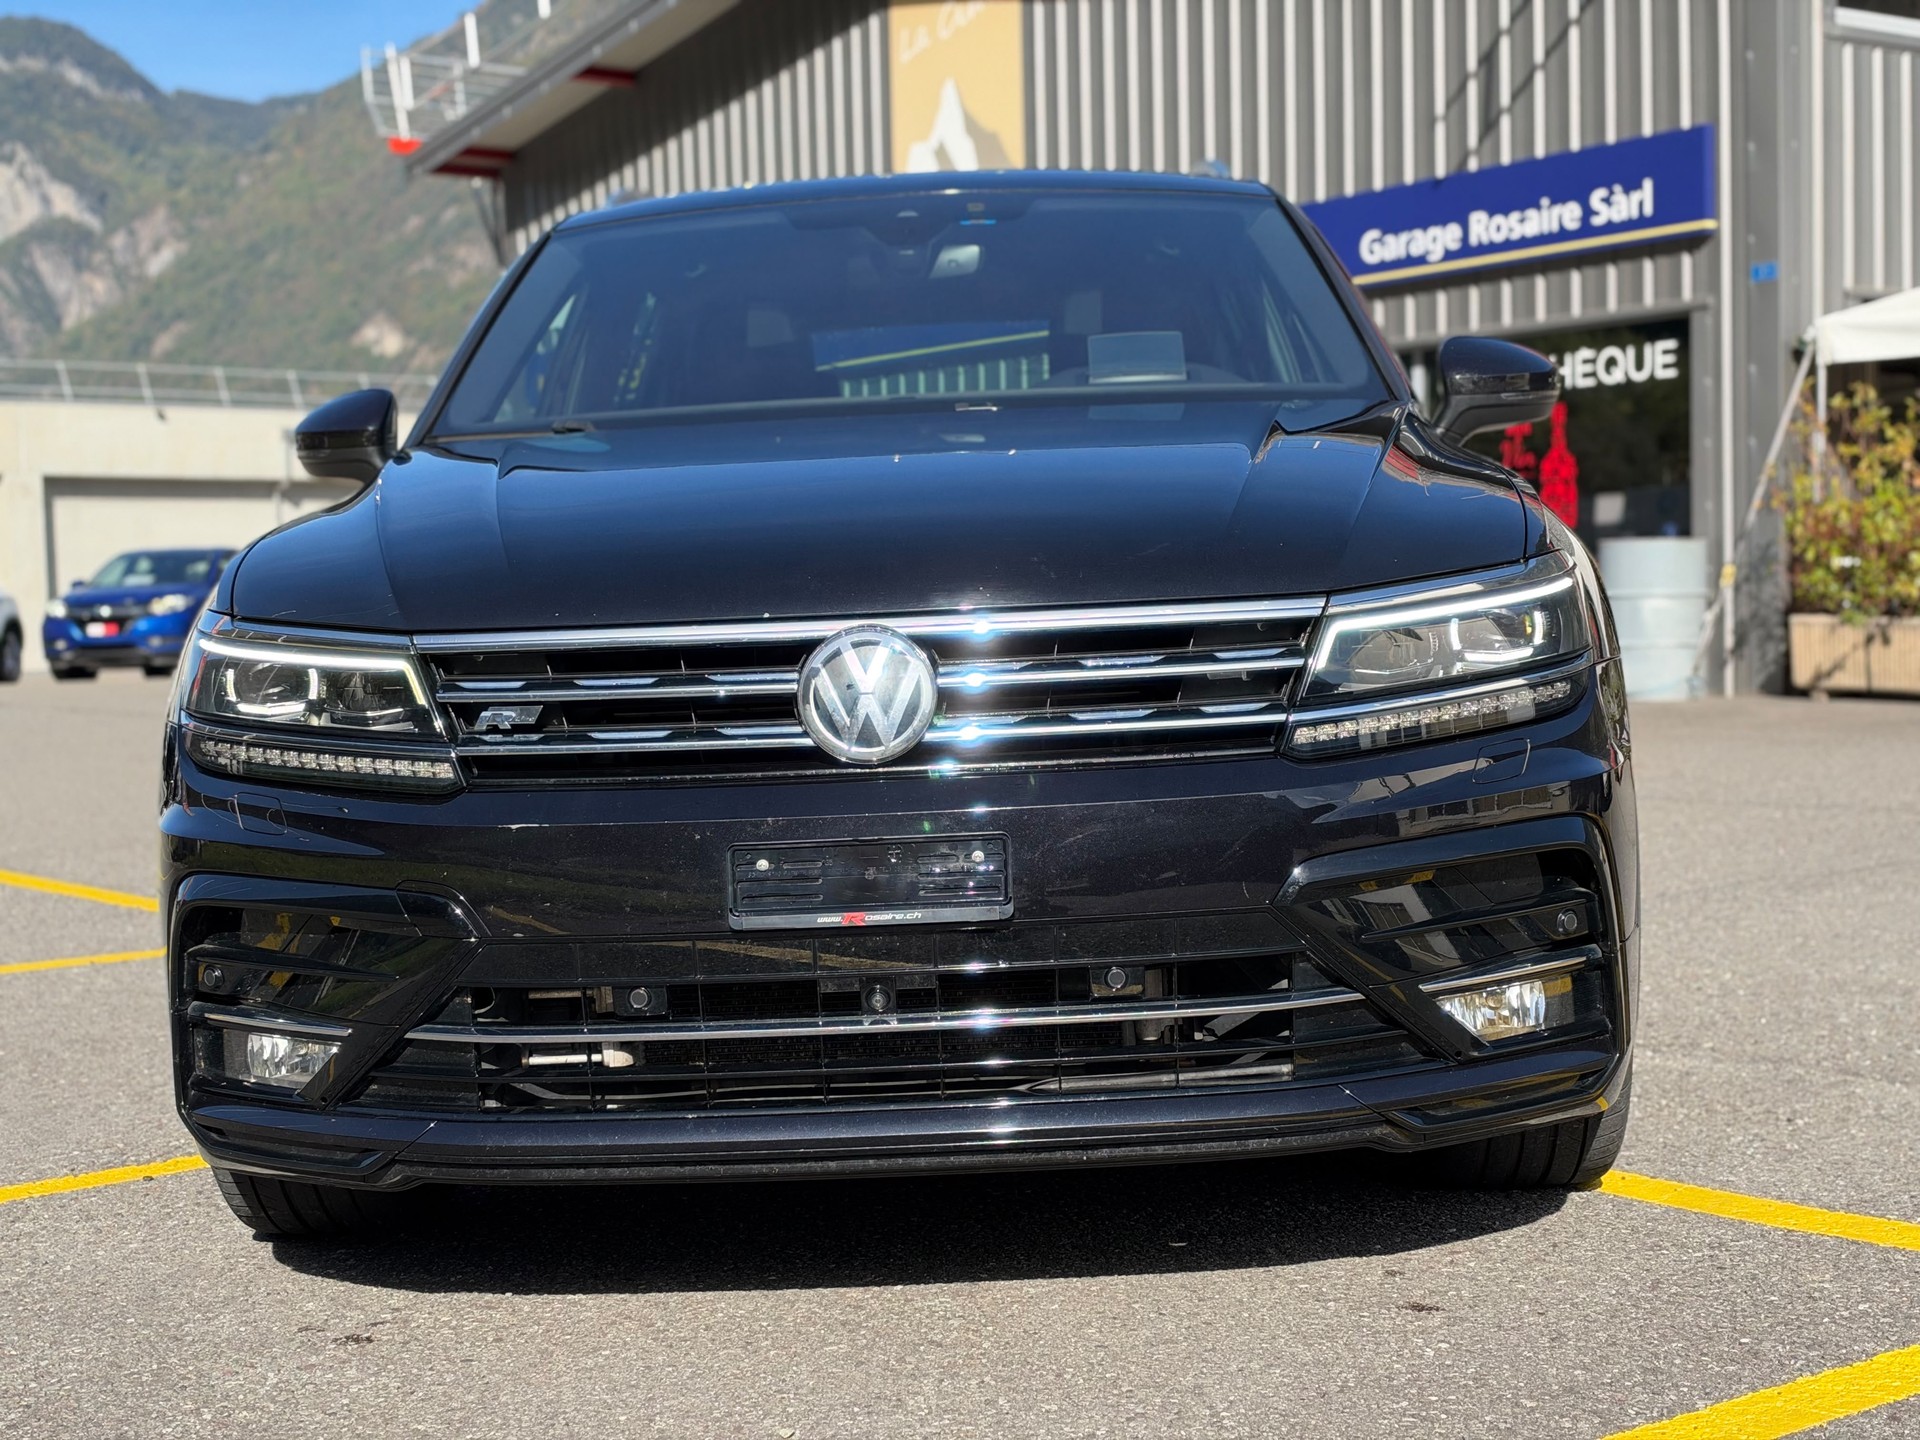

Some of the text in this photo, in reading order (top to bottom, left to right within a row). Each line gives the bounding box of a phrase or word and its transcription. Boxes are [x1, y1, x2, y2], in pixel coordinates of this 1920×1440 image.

[1359, 221, 1463, 265] Garage
[1468, 196, 1583, 247] Rosaire
[817, 911, 922, 926] www.Rosaire.ch
